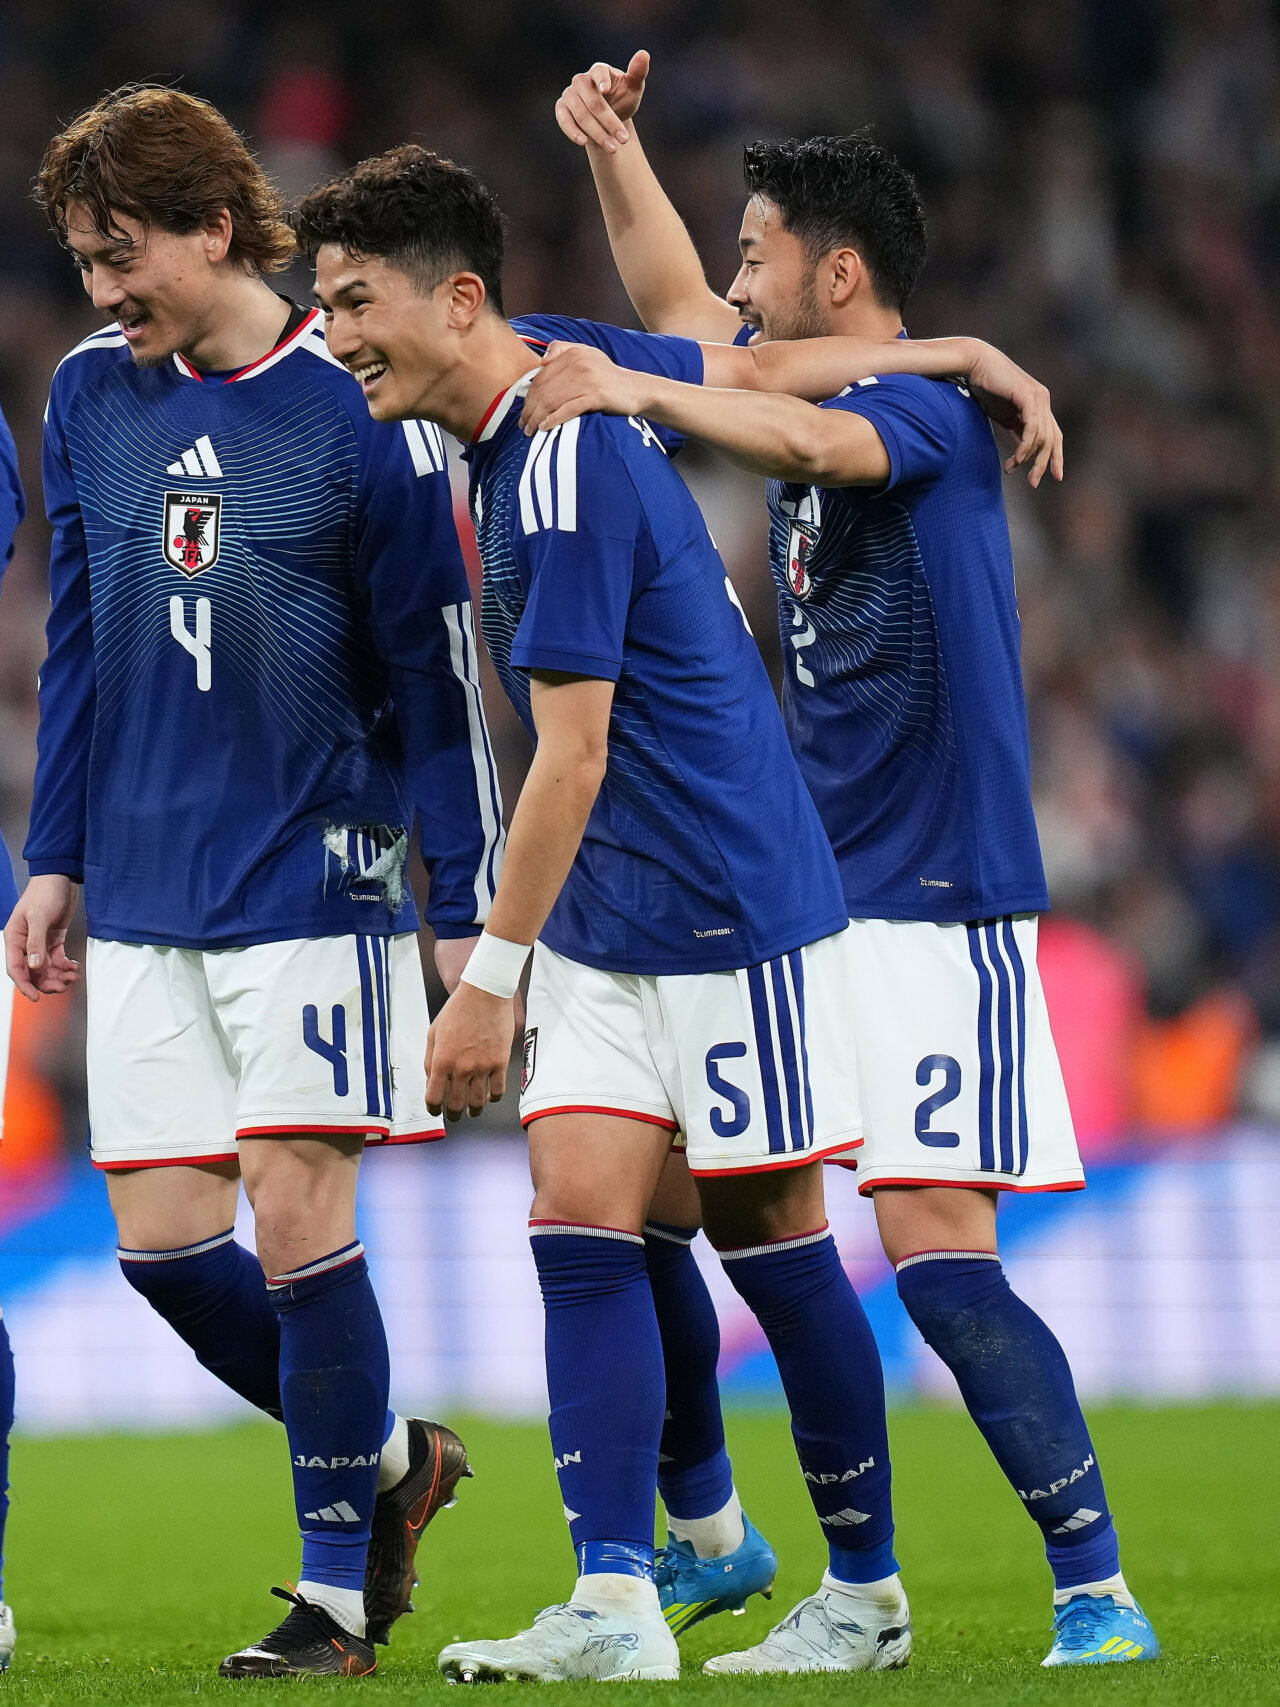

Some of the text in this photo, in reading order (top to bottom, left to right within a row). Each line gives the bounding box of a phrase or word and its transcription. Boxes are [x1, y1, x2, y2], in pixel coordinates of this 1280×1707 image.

[180, 496, 209, 504] JAPAN
[179, 550, 203, 563] JFA
[170, 596, 212, 692] 4
[303, 1004, 349, 1097] 4
[705, 1041, 751, 1138] 5
[915, 1054, 961, 1148] 2
[294, 1452, 379, 1469] JAPAN
[805, 1456, 875, 1485] APAN
